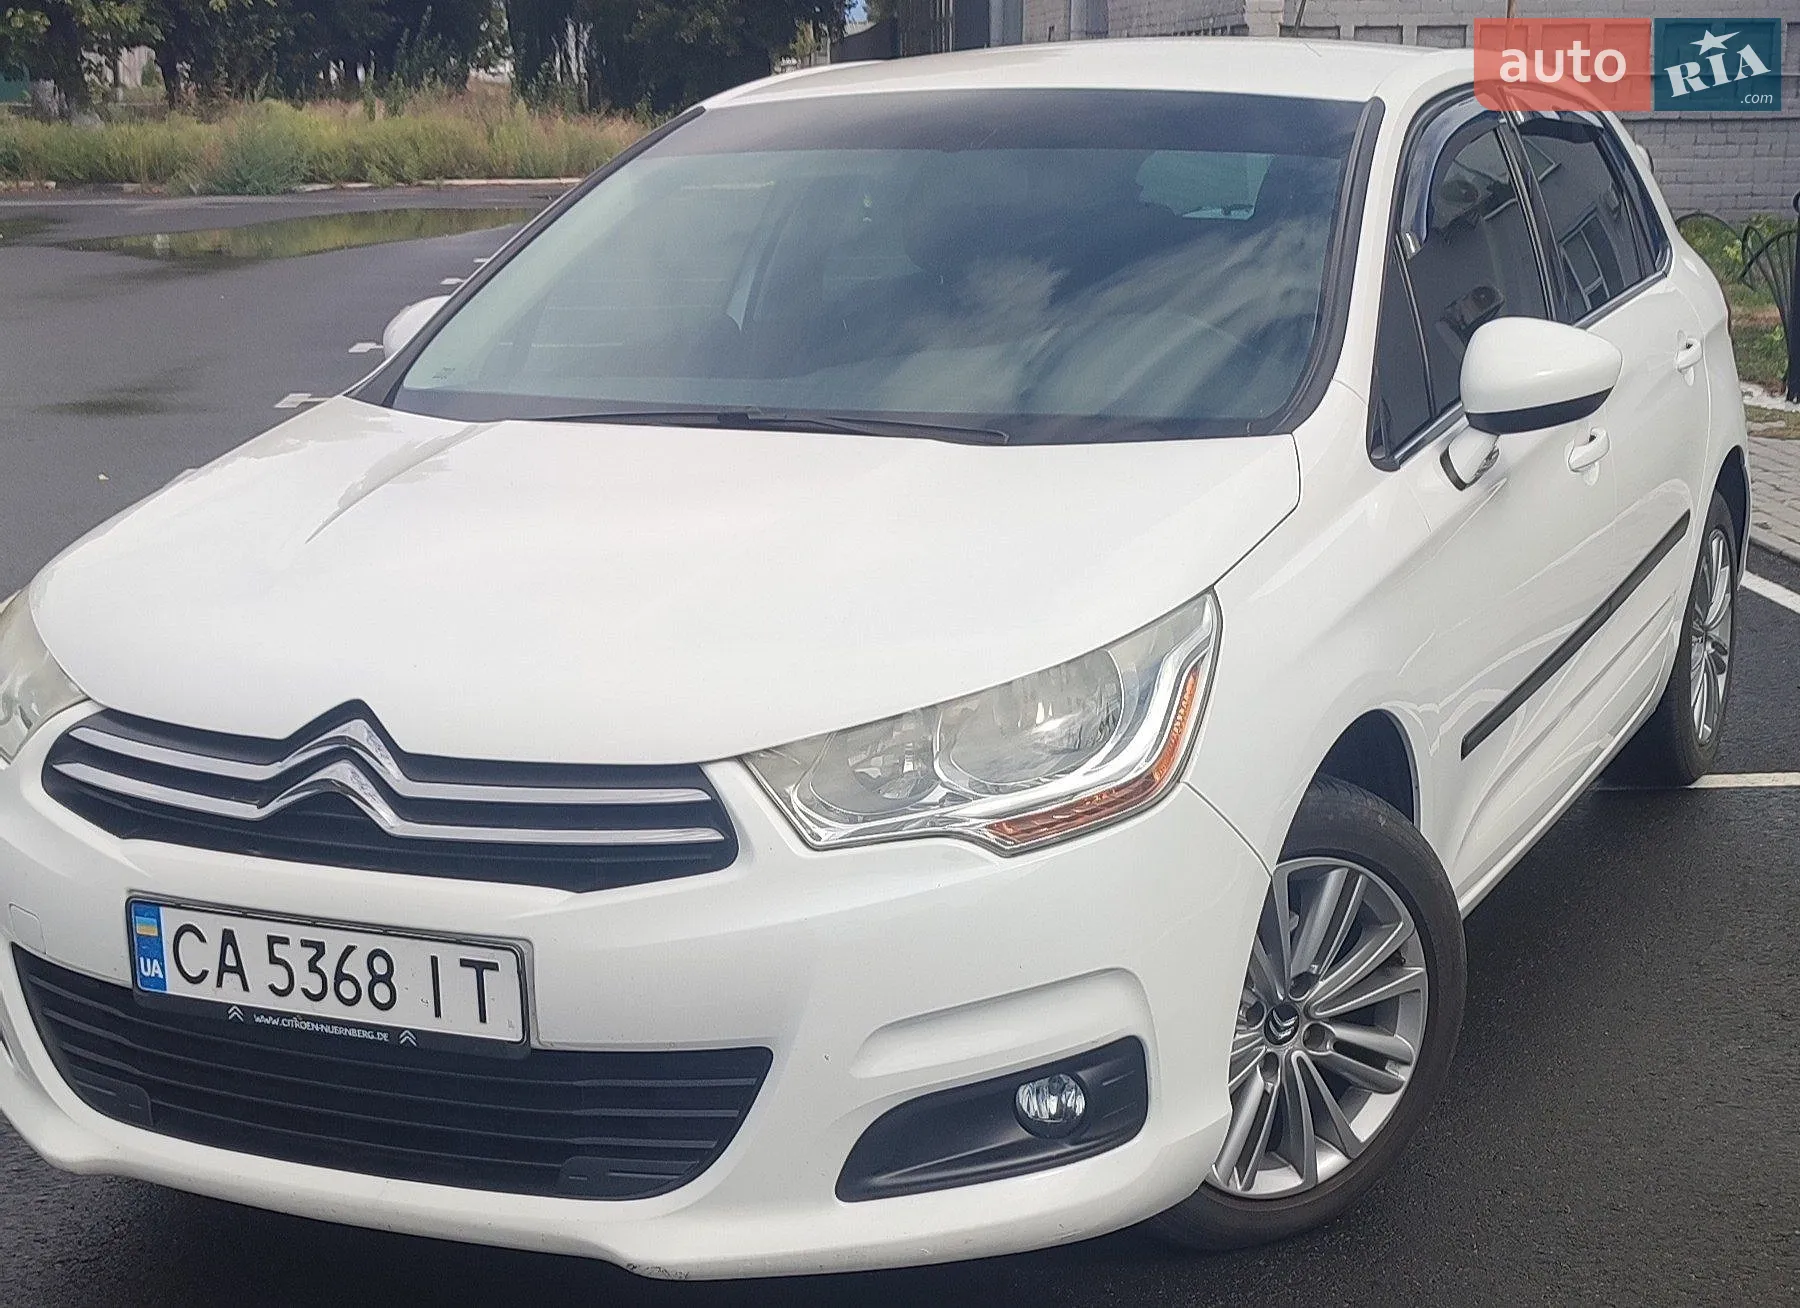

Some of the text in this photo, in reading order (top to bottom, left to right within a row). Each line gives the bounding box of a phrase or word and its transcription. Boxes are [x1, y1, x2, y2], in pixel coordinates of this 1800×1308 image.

[139, 956, 165, 979] UA
[172, 923, 500, 1024] CA 5368 IT
